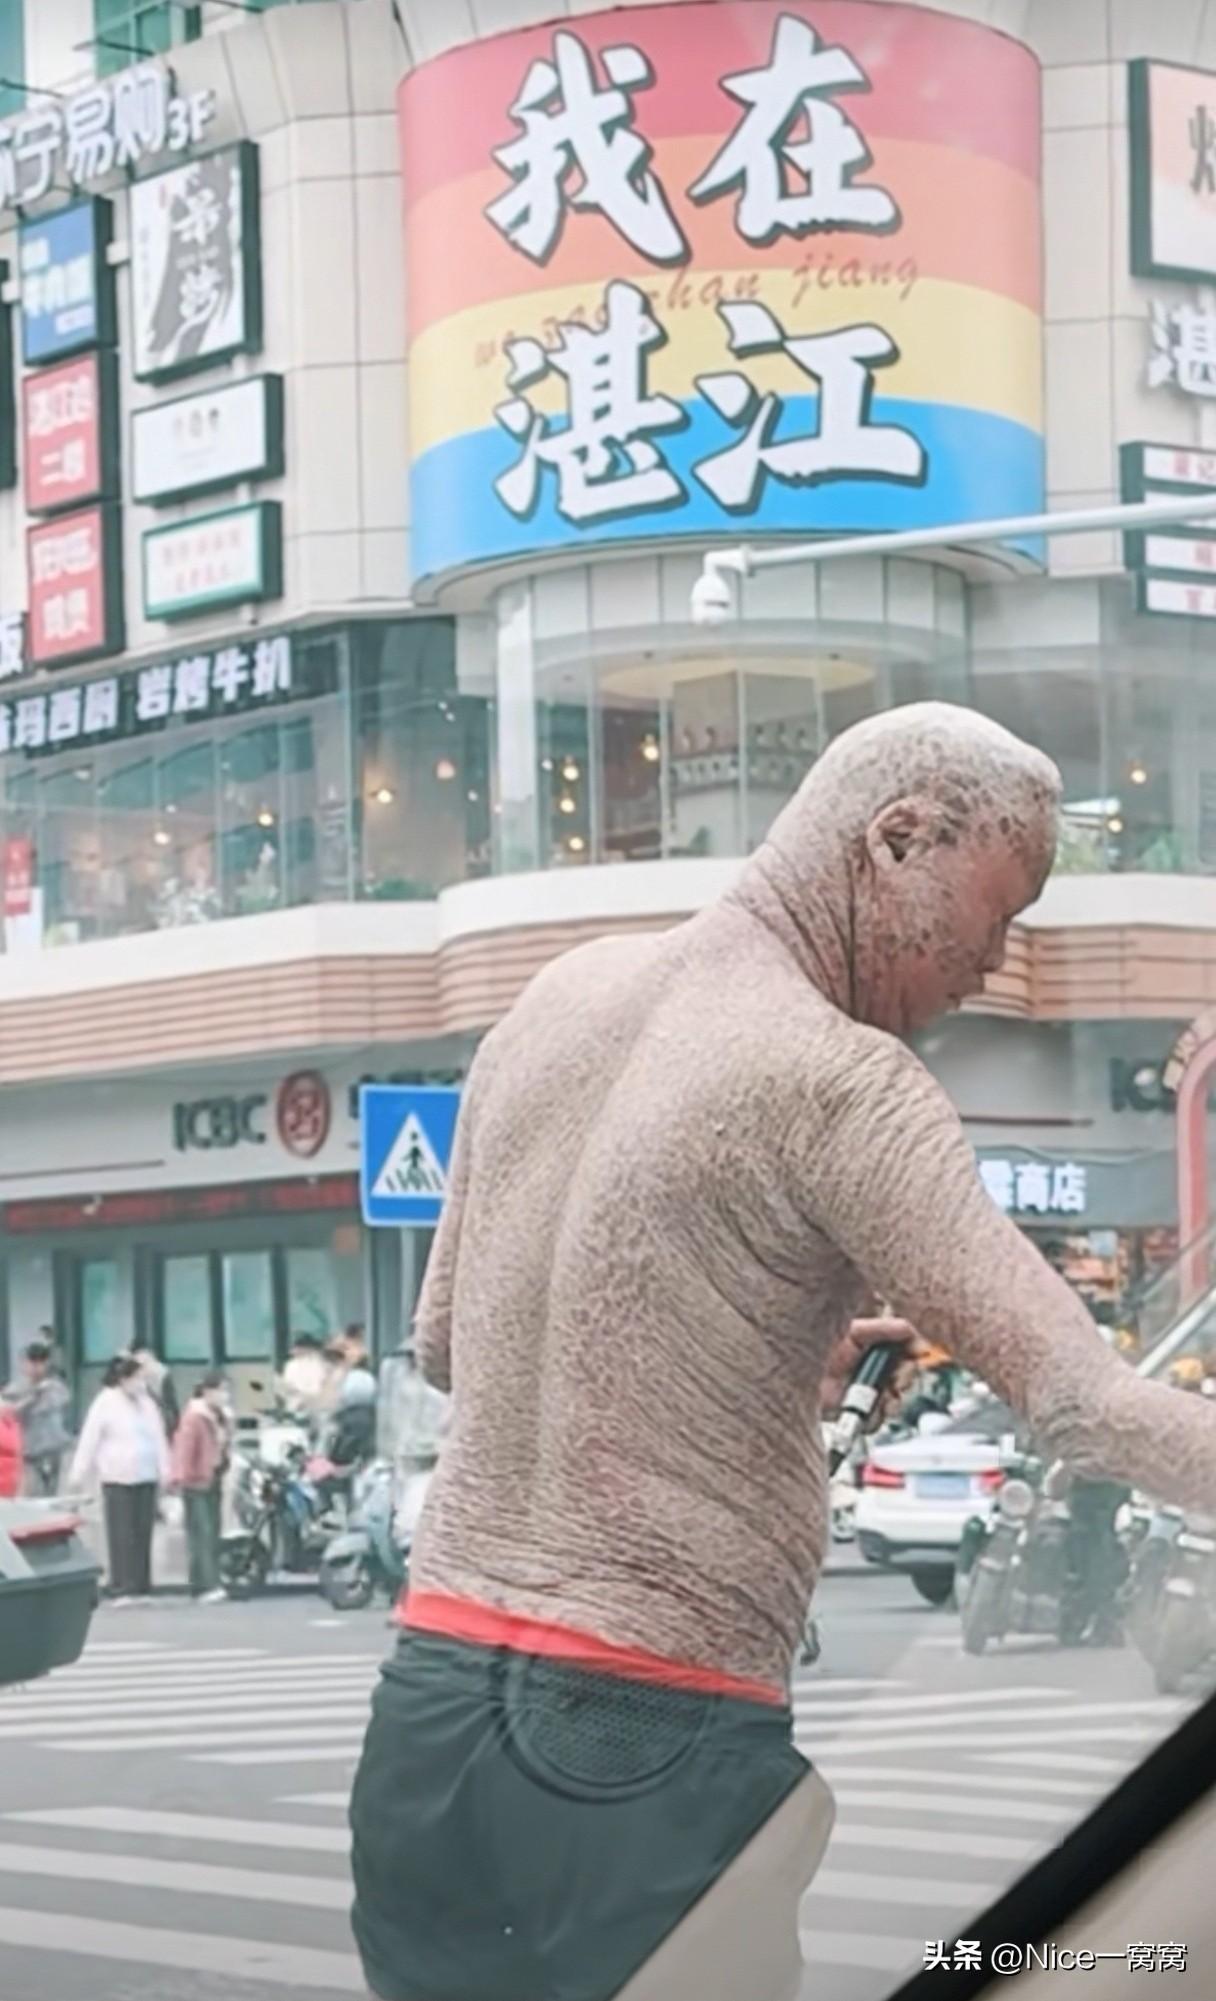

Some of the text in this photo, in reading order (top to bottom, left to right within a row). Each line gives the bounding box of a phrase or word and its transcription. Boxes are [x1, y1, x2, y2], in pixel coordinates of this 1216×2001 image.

[484, 14, 900, 264] 我在
[790, 253, 919, 302] jiang
[492, 279, 926, 525] 湛江
[174, 1093, 268, 1153] ICBC
